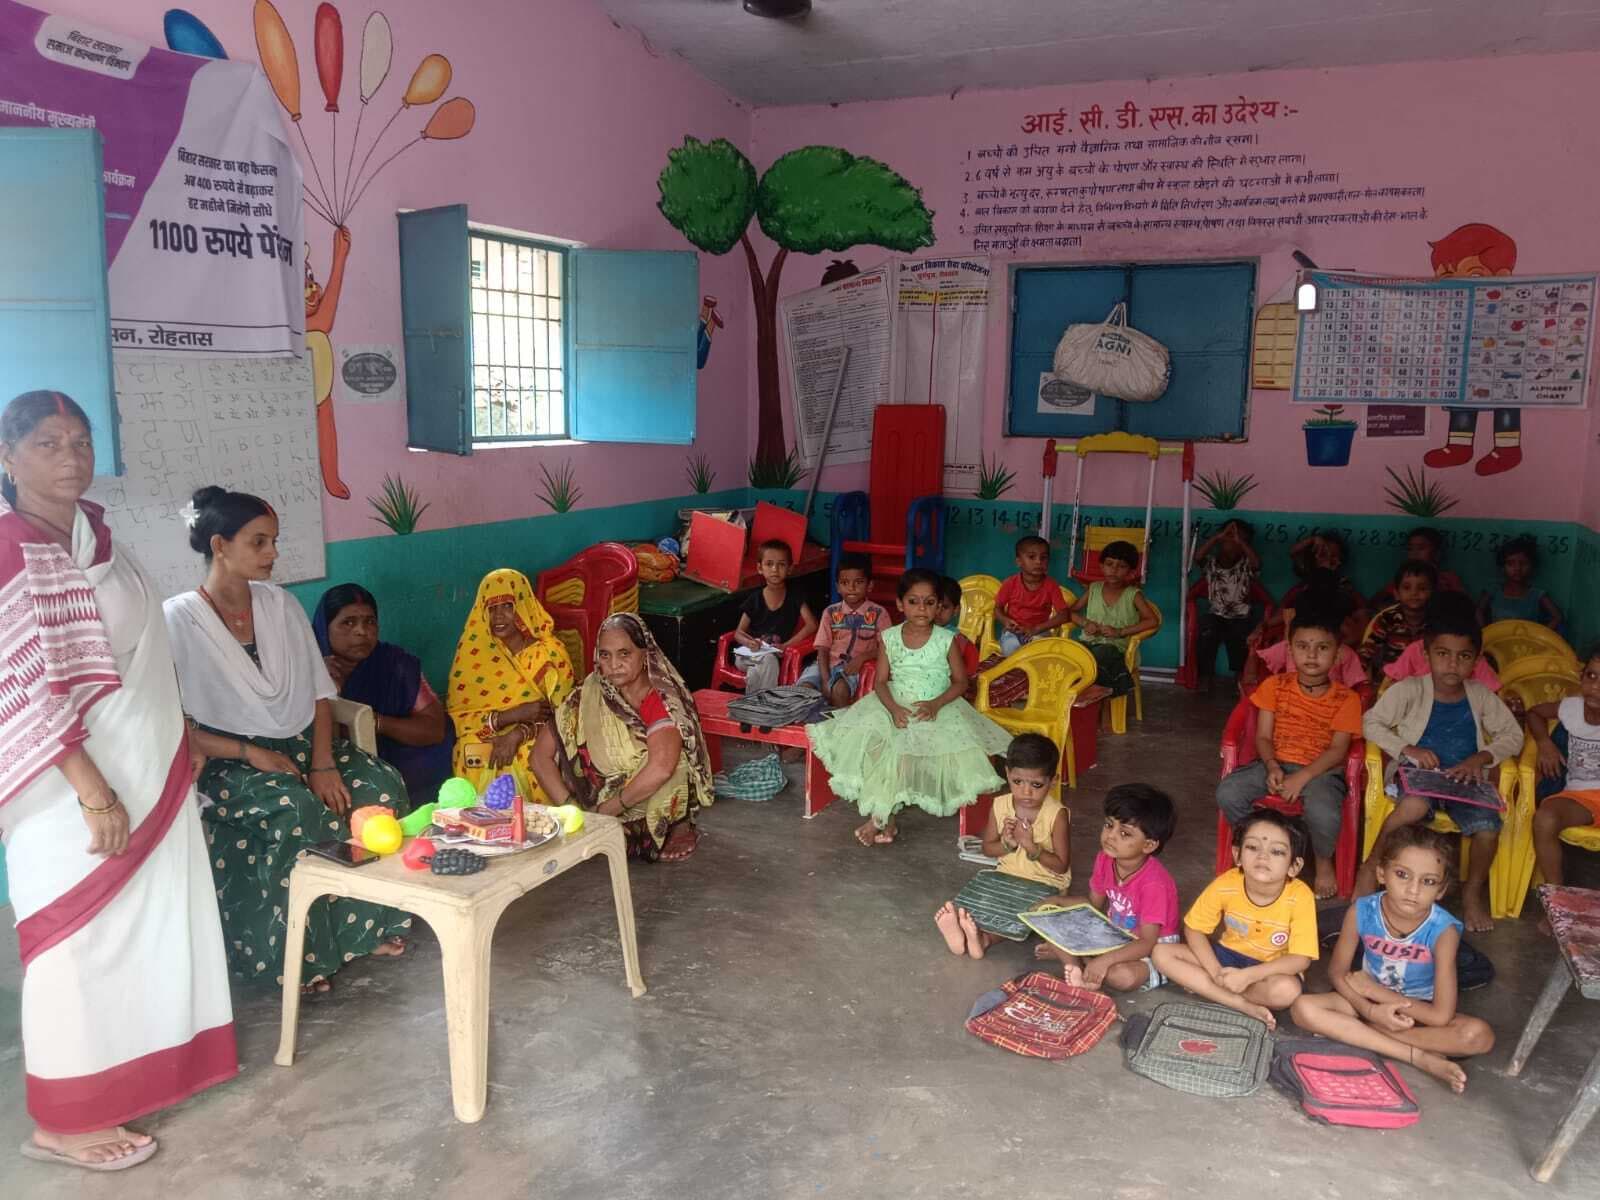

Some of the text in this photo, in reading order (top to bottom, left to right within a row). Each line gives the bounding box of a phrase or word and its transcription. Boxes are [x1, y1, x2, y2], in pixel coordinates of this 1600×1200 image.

[150, 218, 199, 255] 1100
[202, 223, 254, 259] रुपये
[148, 324, 214, 347] रोहतास
[1369, 940, 1425, 960] JUST
